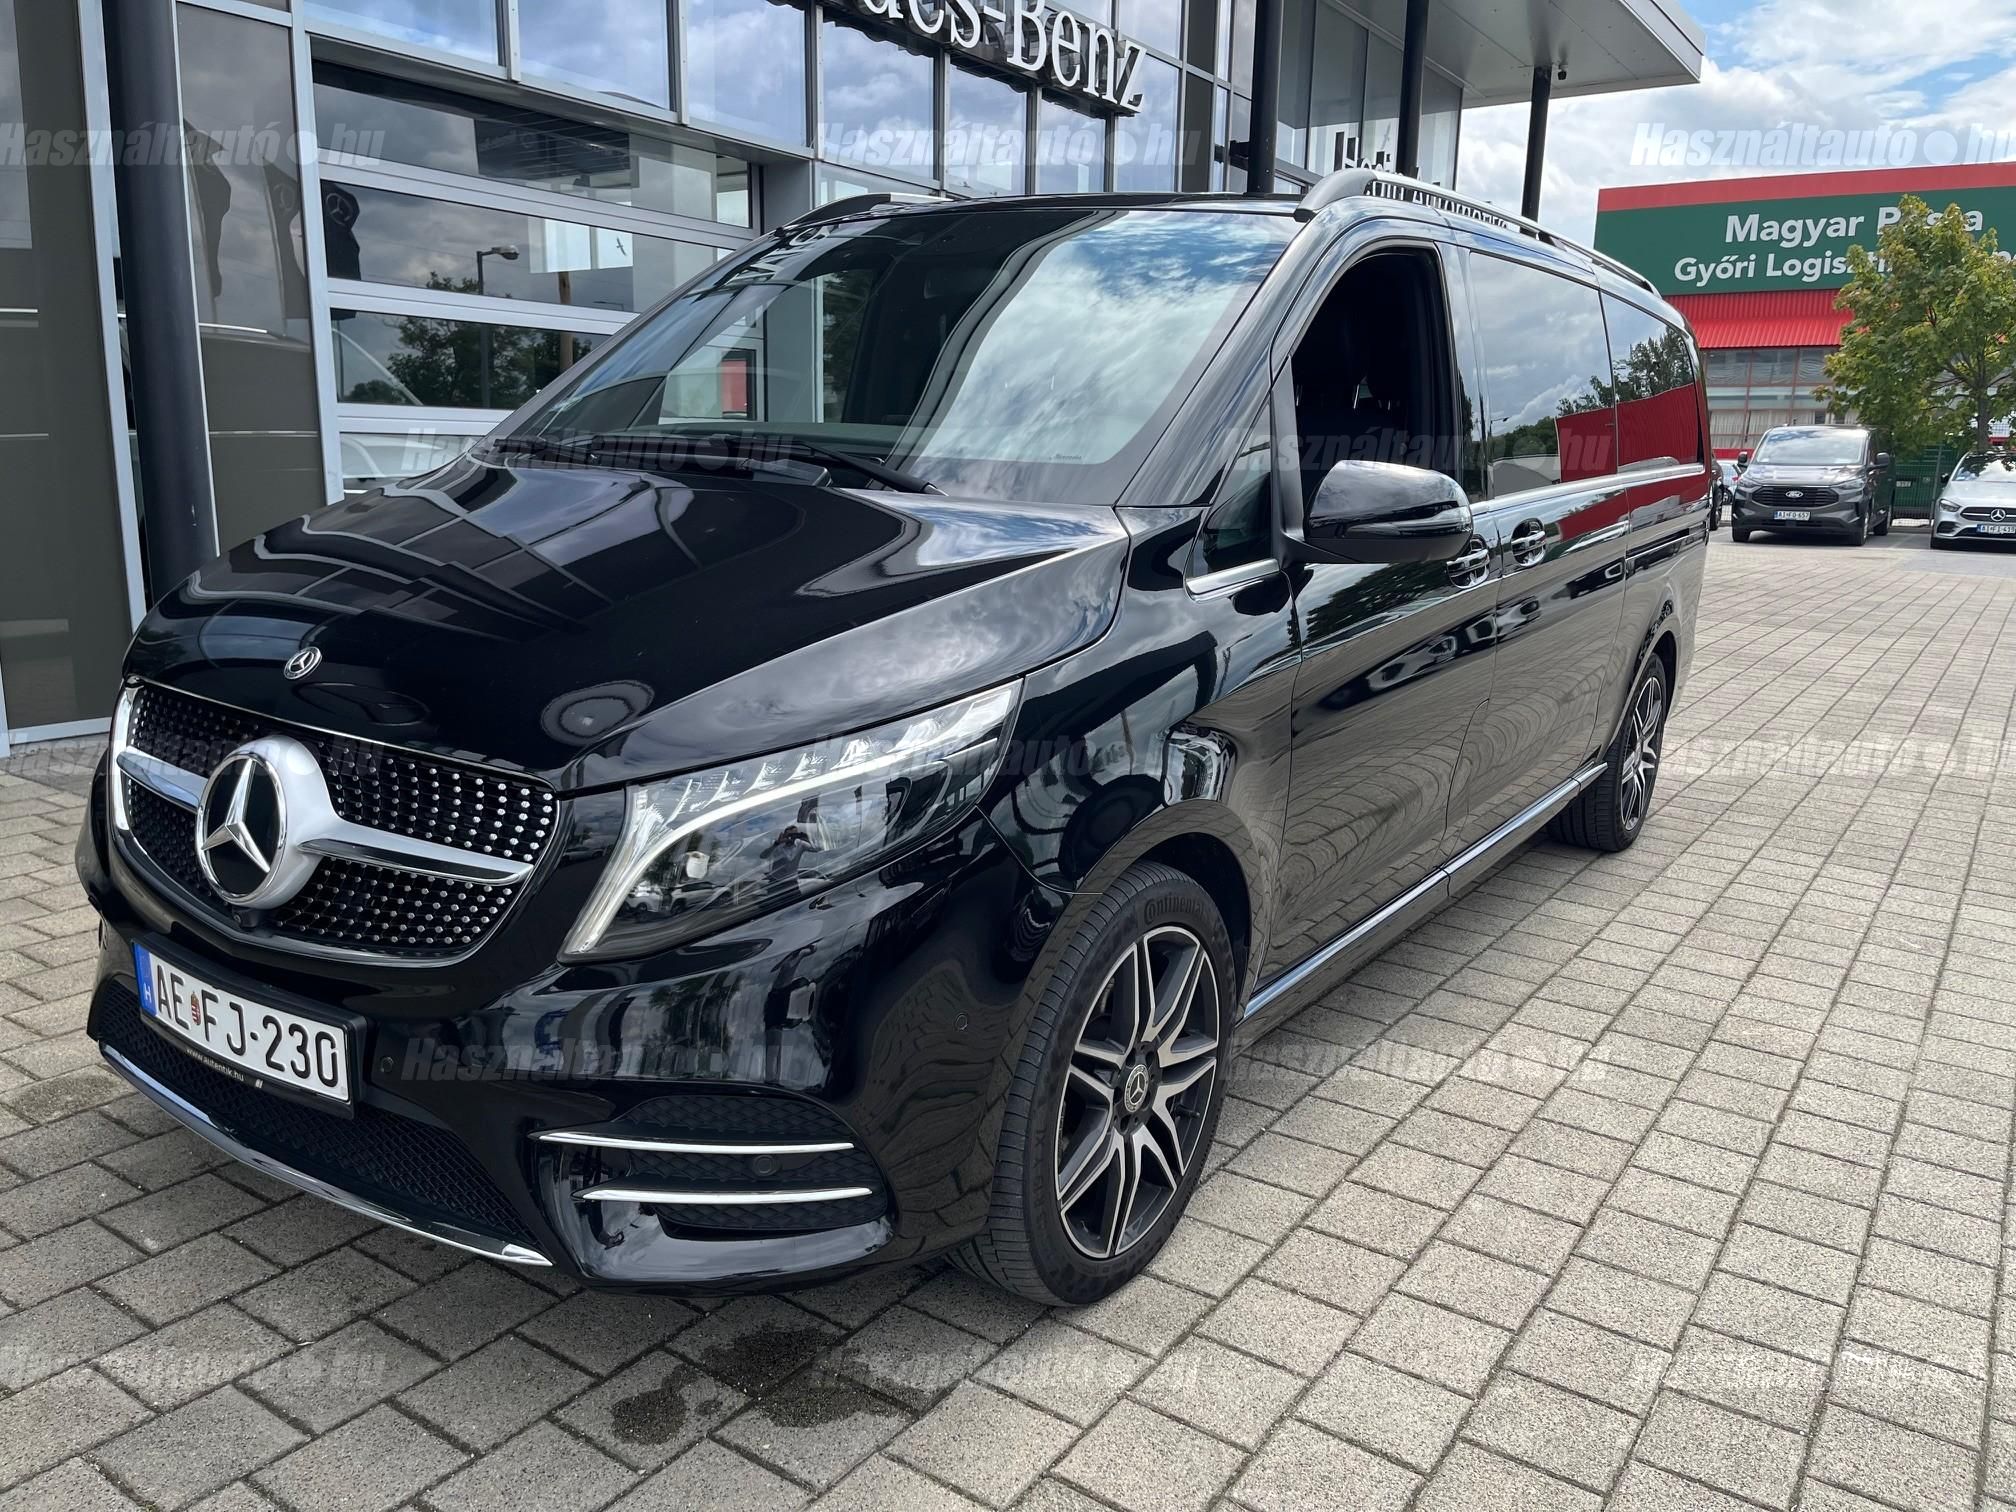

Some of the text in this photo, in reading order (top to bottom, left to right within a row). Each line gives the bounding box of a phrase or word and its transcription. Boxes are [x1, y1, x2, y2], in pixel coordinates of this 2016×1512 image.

[1725, 213, 1865, 249] Magyar
[1673, 254, 1757, 287] Győri
[143, 983, 153, 1004] H
